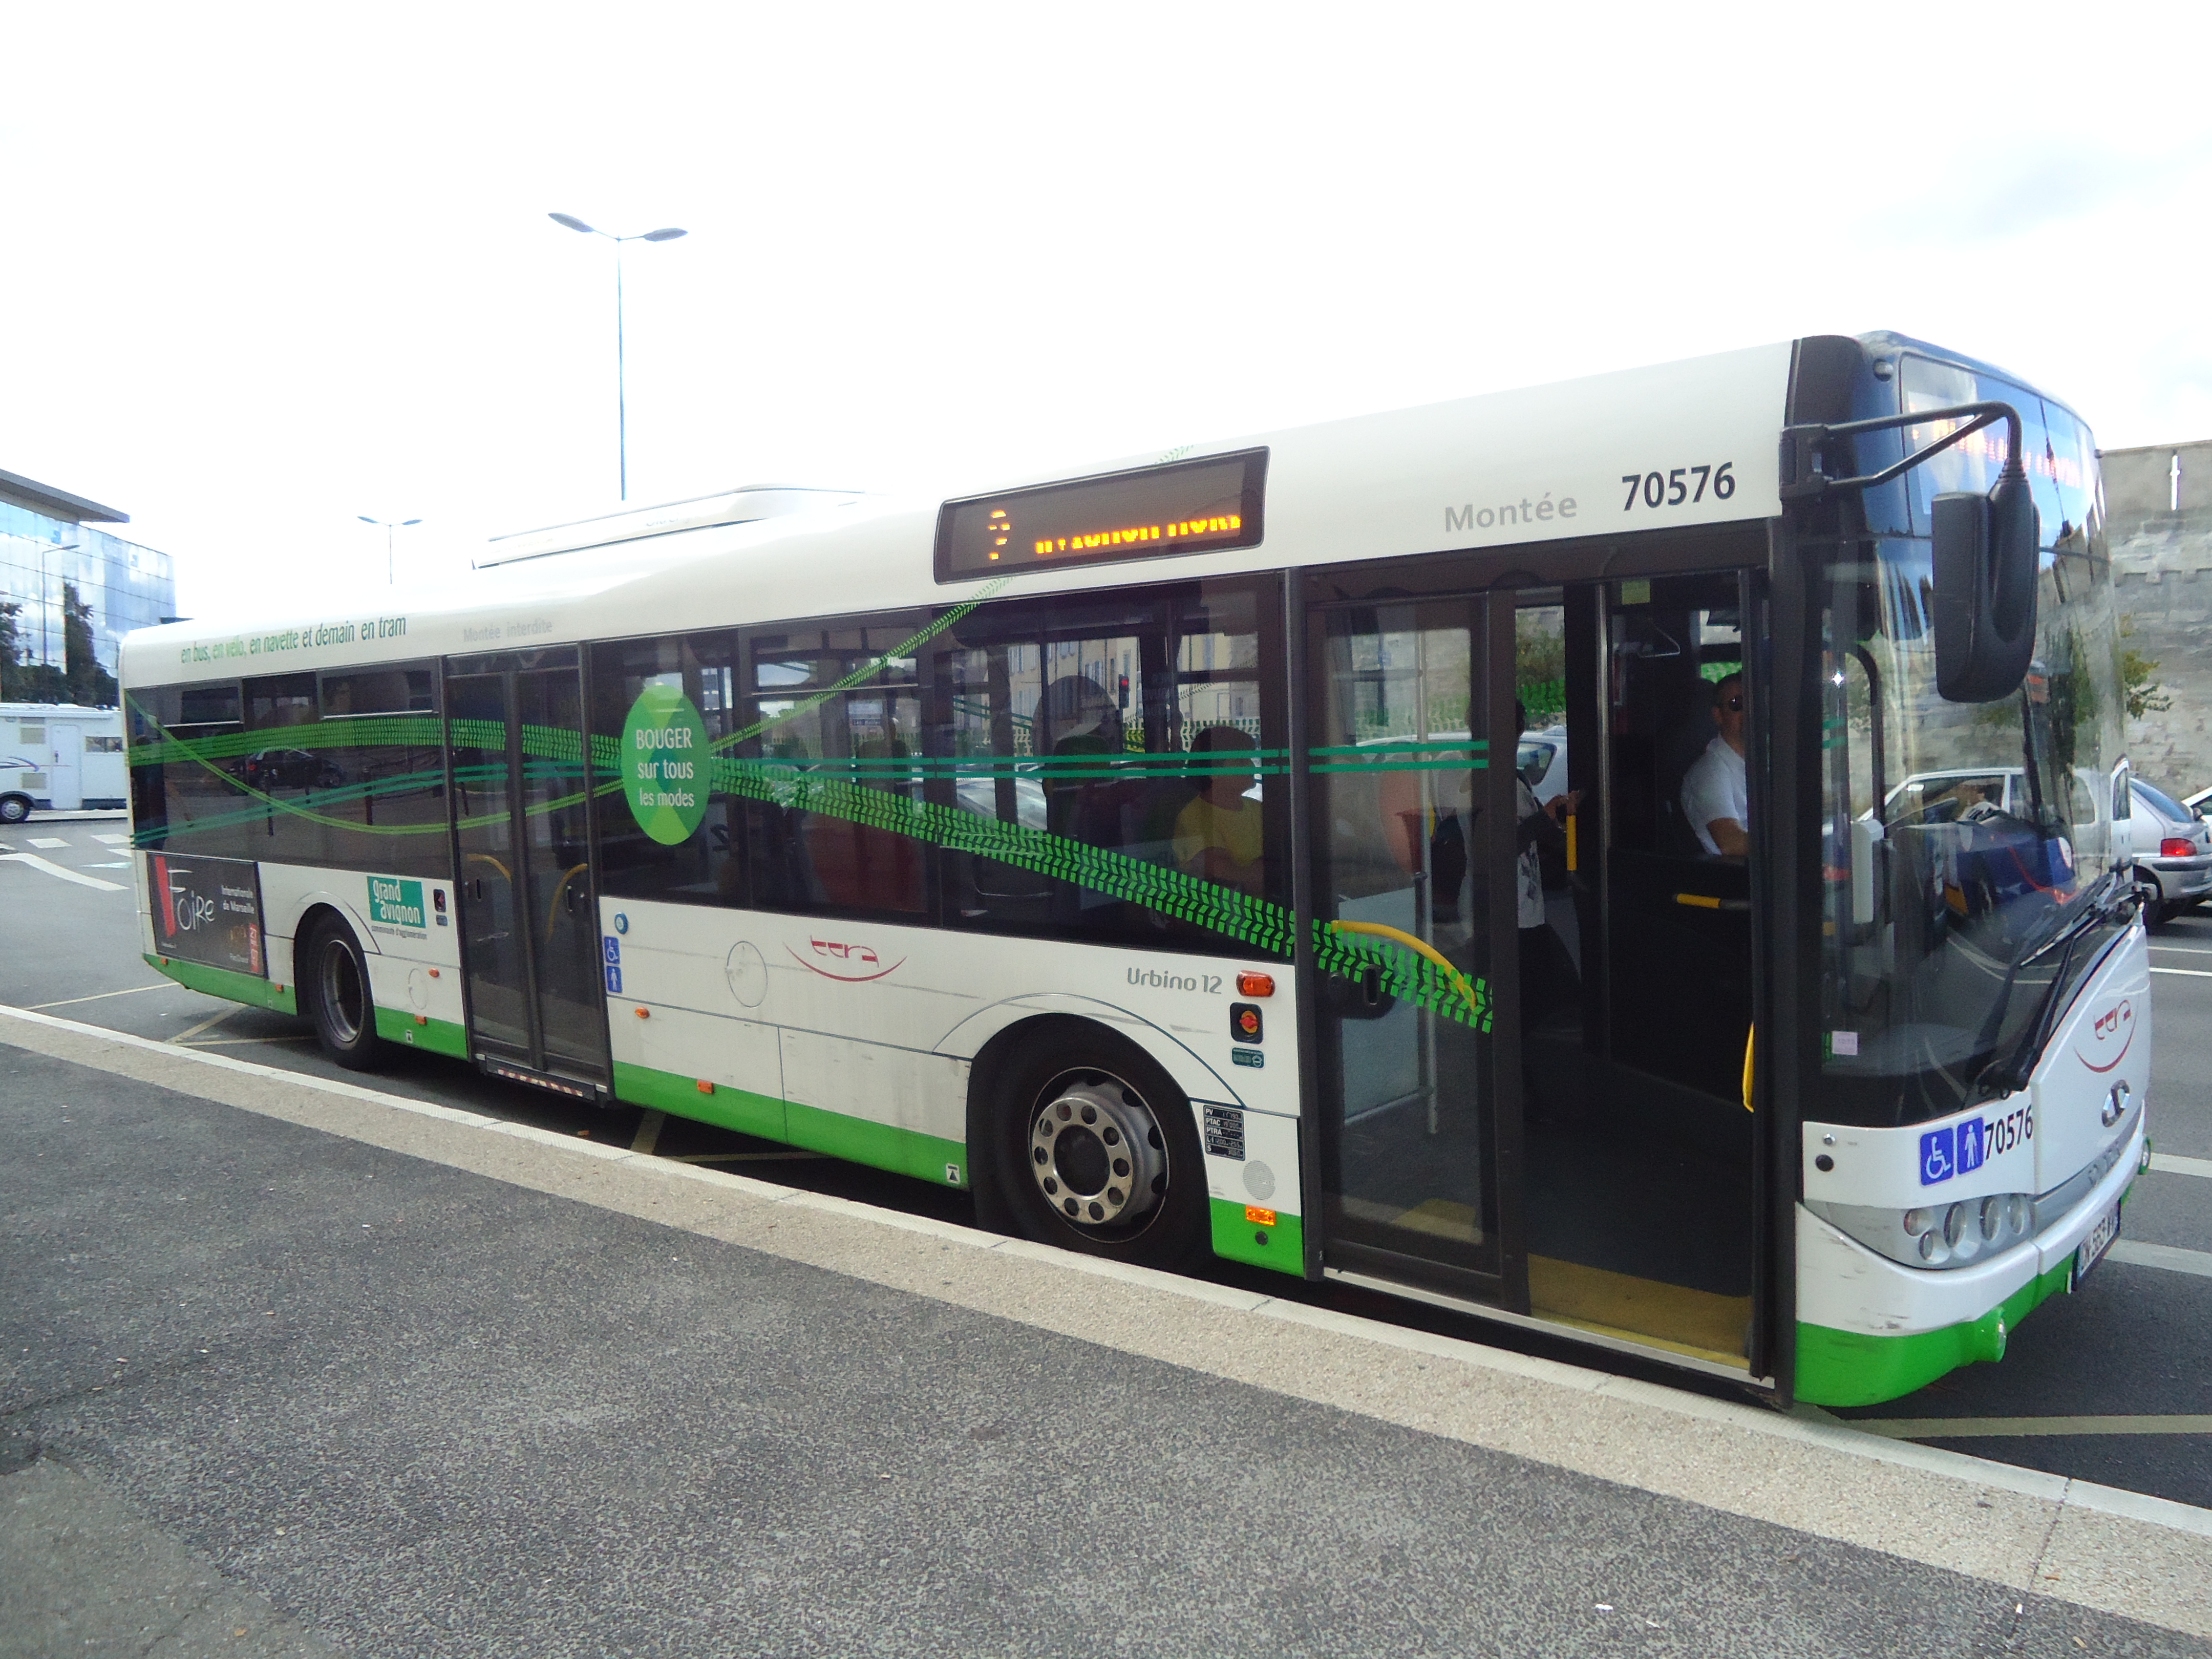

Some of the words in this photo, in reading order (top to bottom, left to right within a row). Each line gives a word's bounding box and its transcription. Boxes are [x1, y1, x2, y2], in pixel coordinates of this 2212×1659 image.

[1622, 462, 1736, 511] 70576
[1445, 493, 1578, 532] Montée
[181, 648, 191, 663] en
[212, 644, 224, 658] en
[250, 638, 261, 654] en
[264, 630, 299, 652] navette
[302, 632, 313, 647] et
[316, 621, 354, 646] demain
[361, 621, 375, 641] en
[379, 617, 407, 637] tram
[636, 728, 693, 749] BOUGER
[637, 763, 660, 779] sur
[663, 759, 694, 779] tous
[640, 788, 654, 806] les
[657, 788, 695, 806] modes
[373, 879, 401, 903] grand
[380, 900, 421, 924] avignon
[1127, 967, 1197, 991] Urbino
[1203, 975, 1223, 994] 12
[1206, 1117, 1221, 1126] PTAC
[1206, 1126, 1222, 1136] PTRA
[1985, 1104, 2033, 1160] 70576
